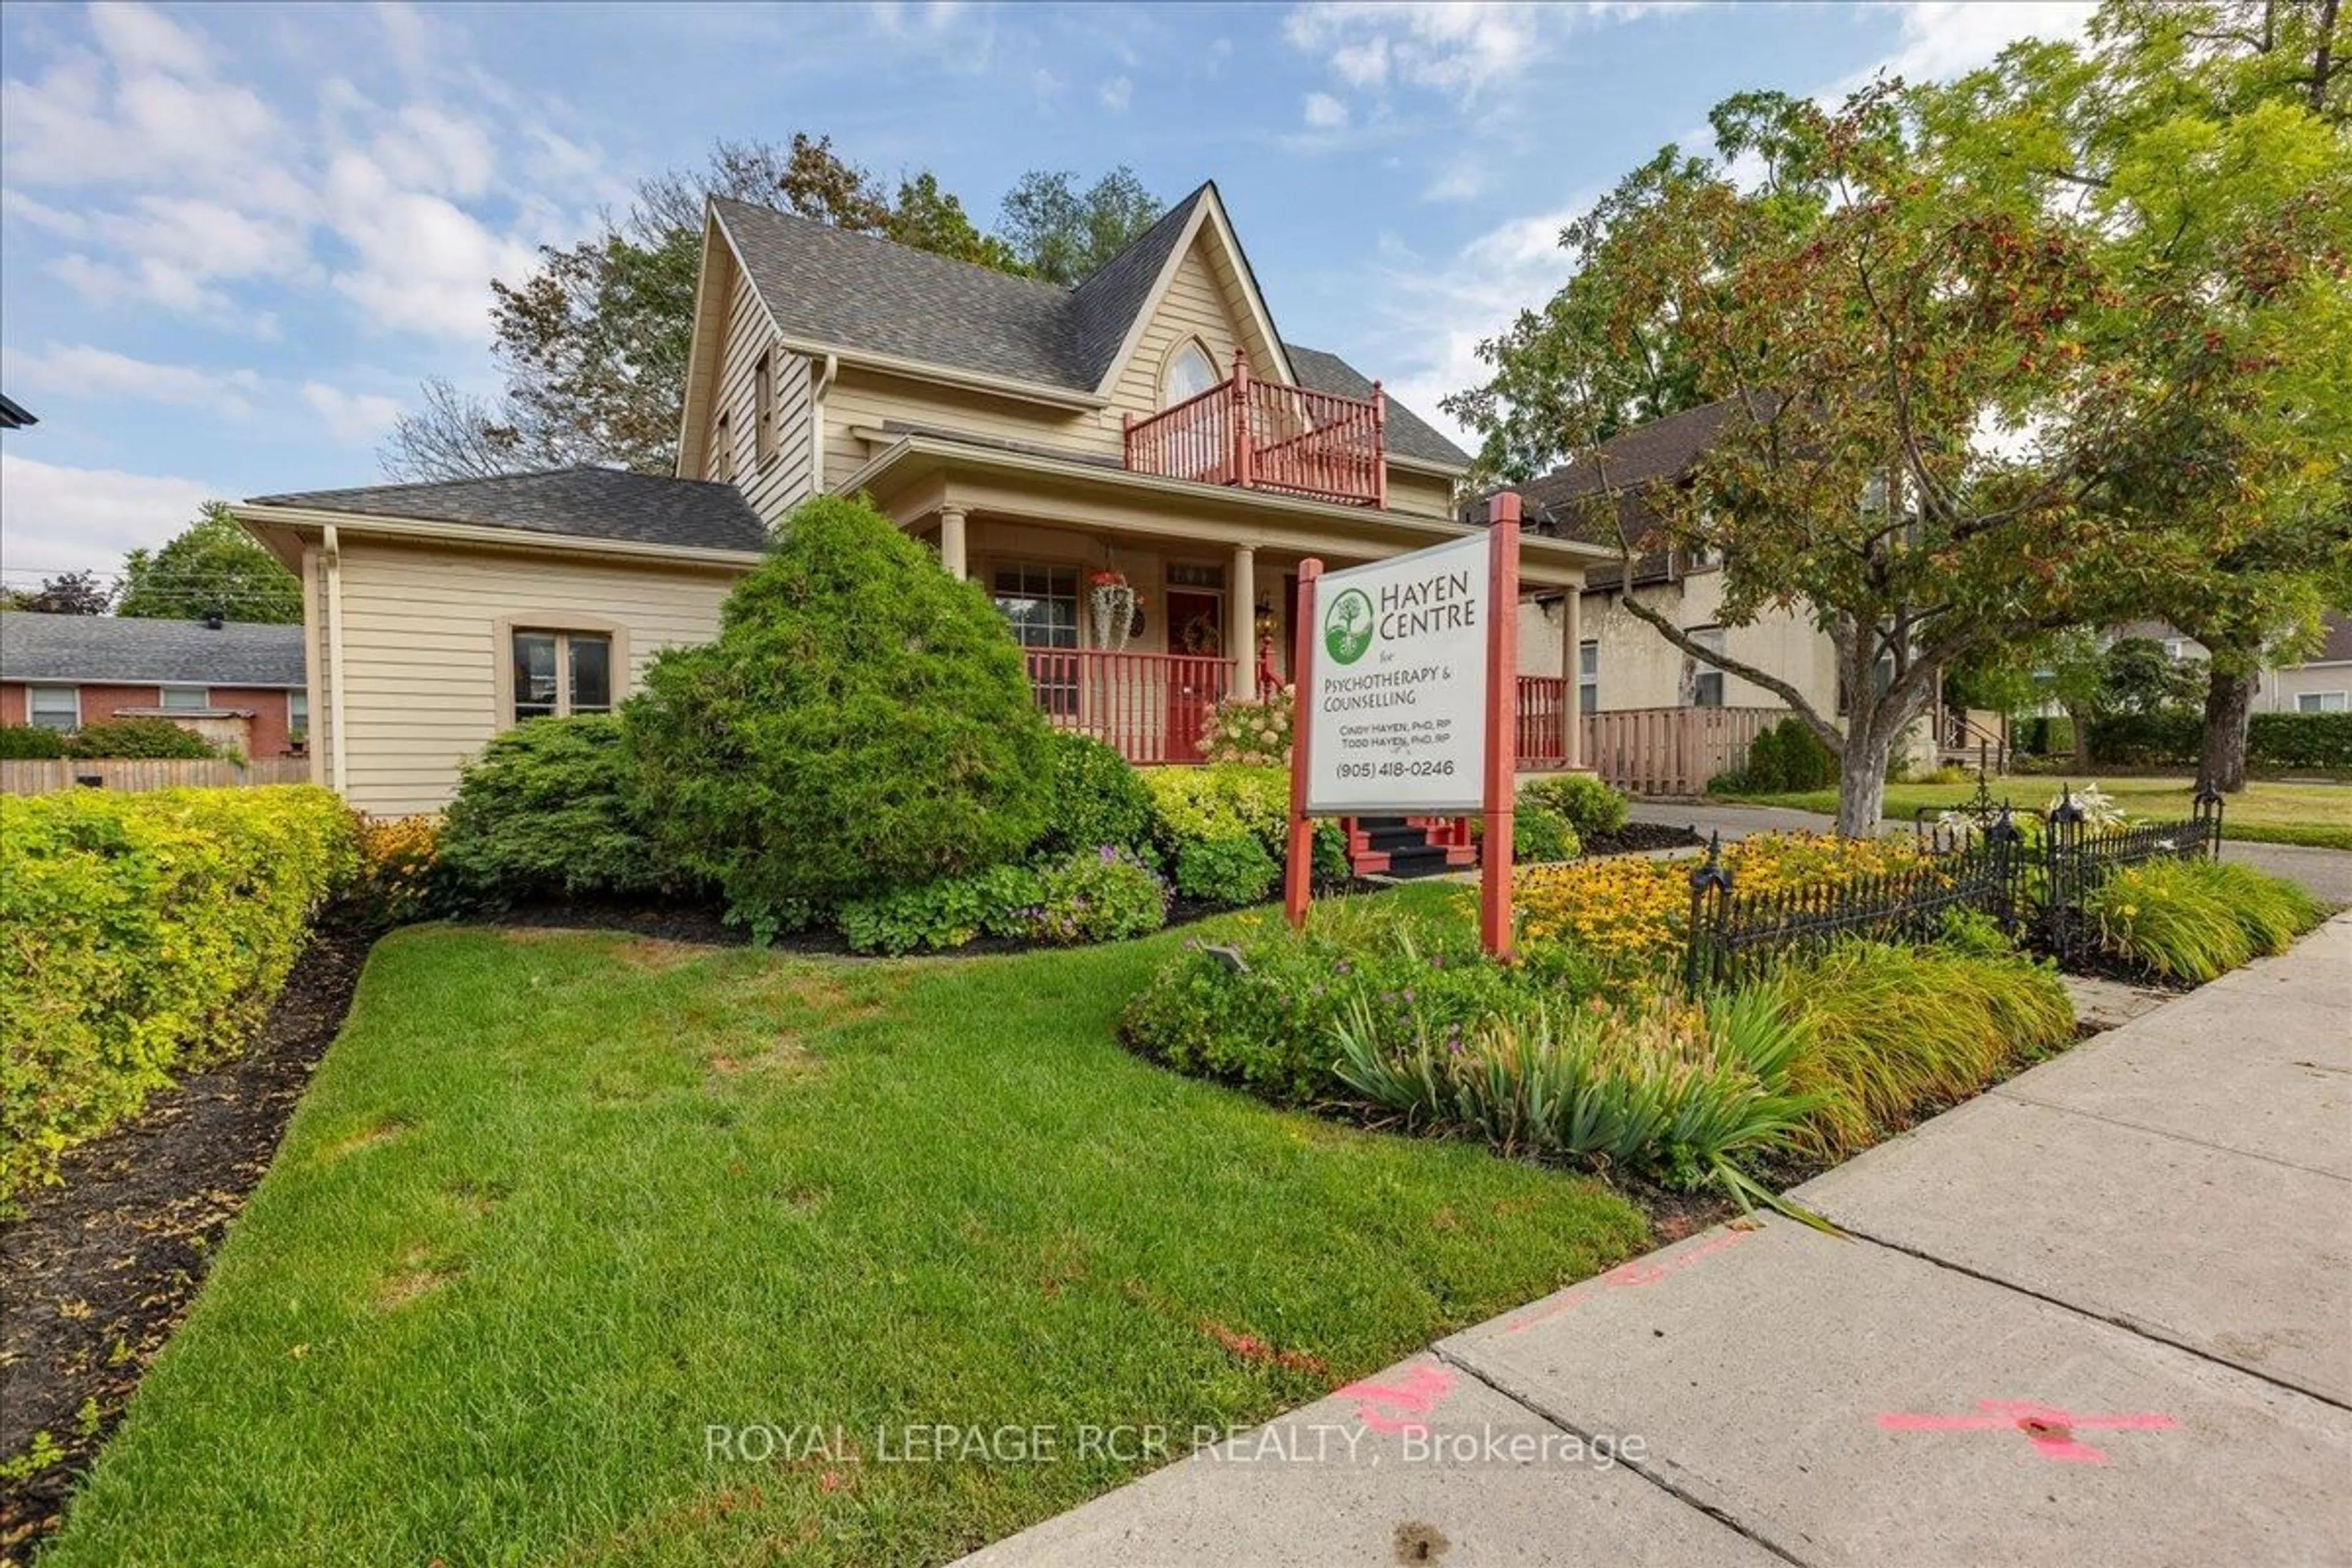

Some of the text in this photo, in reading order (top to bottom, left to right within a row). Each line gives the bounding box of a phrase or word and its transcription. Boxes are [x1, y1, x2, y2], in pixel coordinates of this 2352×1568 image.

[1381, 570, 1468, 613] HAYEN
[1379, 599, 1475, 641] CENTRE
[1325, 665, 1451, 693] PSYCHOTHERAPY &
[1324, 690, 1416, 712] COUNSELLING
[1336, 760, 1455, 779] (905) 418-0246
